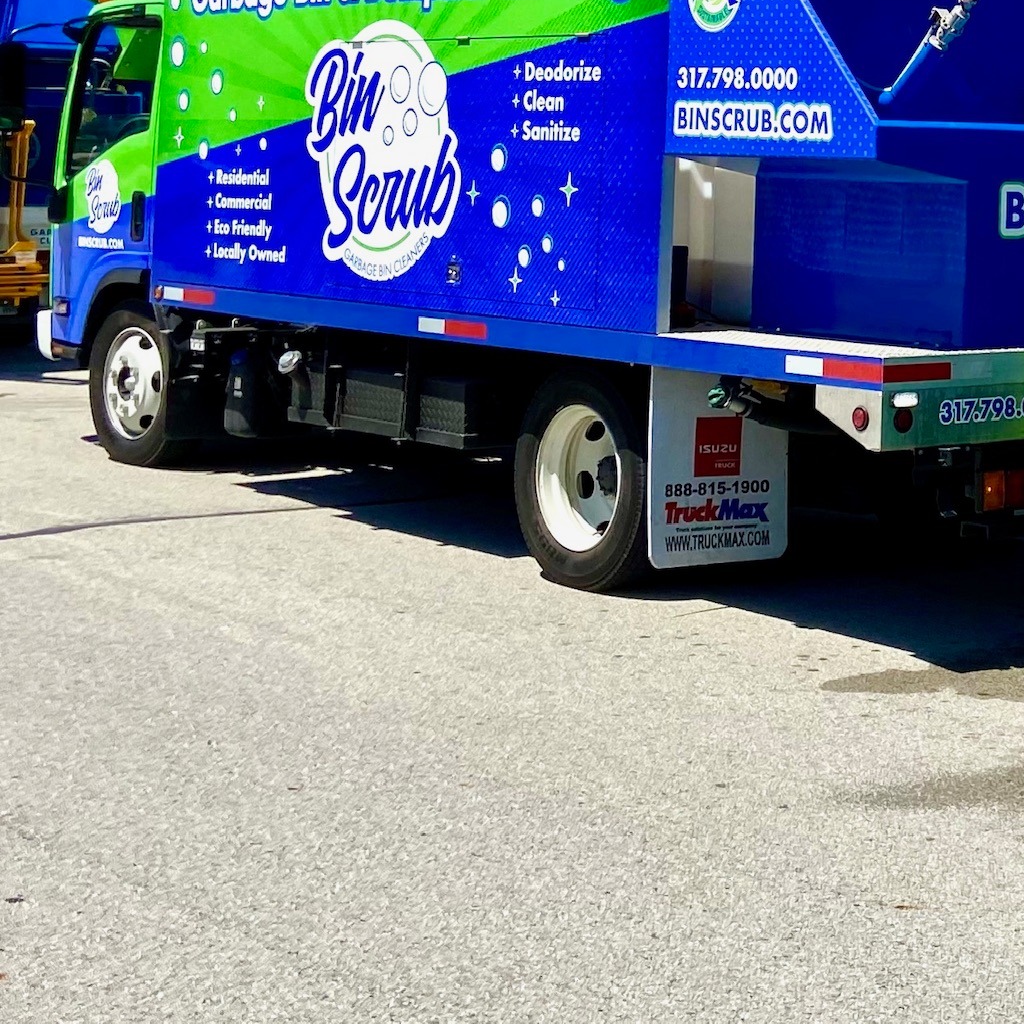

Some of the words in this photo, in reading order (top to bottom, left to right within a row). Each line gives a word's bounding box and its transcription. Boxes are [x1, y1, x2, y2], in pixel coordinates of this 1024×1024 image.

[524, 59, 602, 82] Deodorize
[677, 66, 798, 90] 317.798.0000
[310, 48, 385, 152] Bin
[523, 89, 564, 112] Clean
[522, 120, 581, 142] Sanitize
[677, 106, 829, 135] BINSCRUB.COM
[87, 167, 103, 196] Bin
[216, 168, 270, 185] Residential
[215, 192, 272, 210] Commercial
[327, 134, 456, 249] Scrub
[90, 194, 120, 224] Scrub
[213, 219, 230, 235] Eco
[232, 219, 272, 241] Friendly
[213, 242, 246, 264] Locally
[248, 244, 287, 263] Owned
[344, 248, 377, 276] GARBAGE
[379, 262, 392, 276] BIN
[393, 232, 429, 273] CLEANERS
[699, 444, 737, 454] ISUZU
[665, 479, 770, 498] 888-815-1900
[665, 498, 770, 525] TruckMax
[664, 529, 770, 552] WWW.TRUCKMAX.COM
